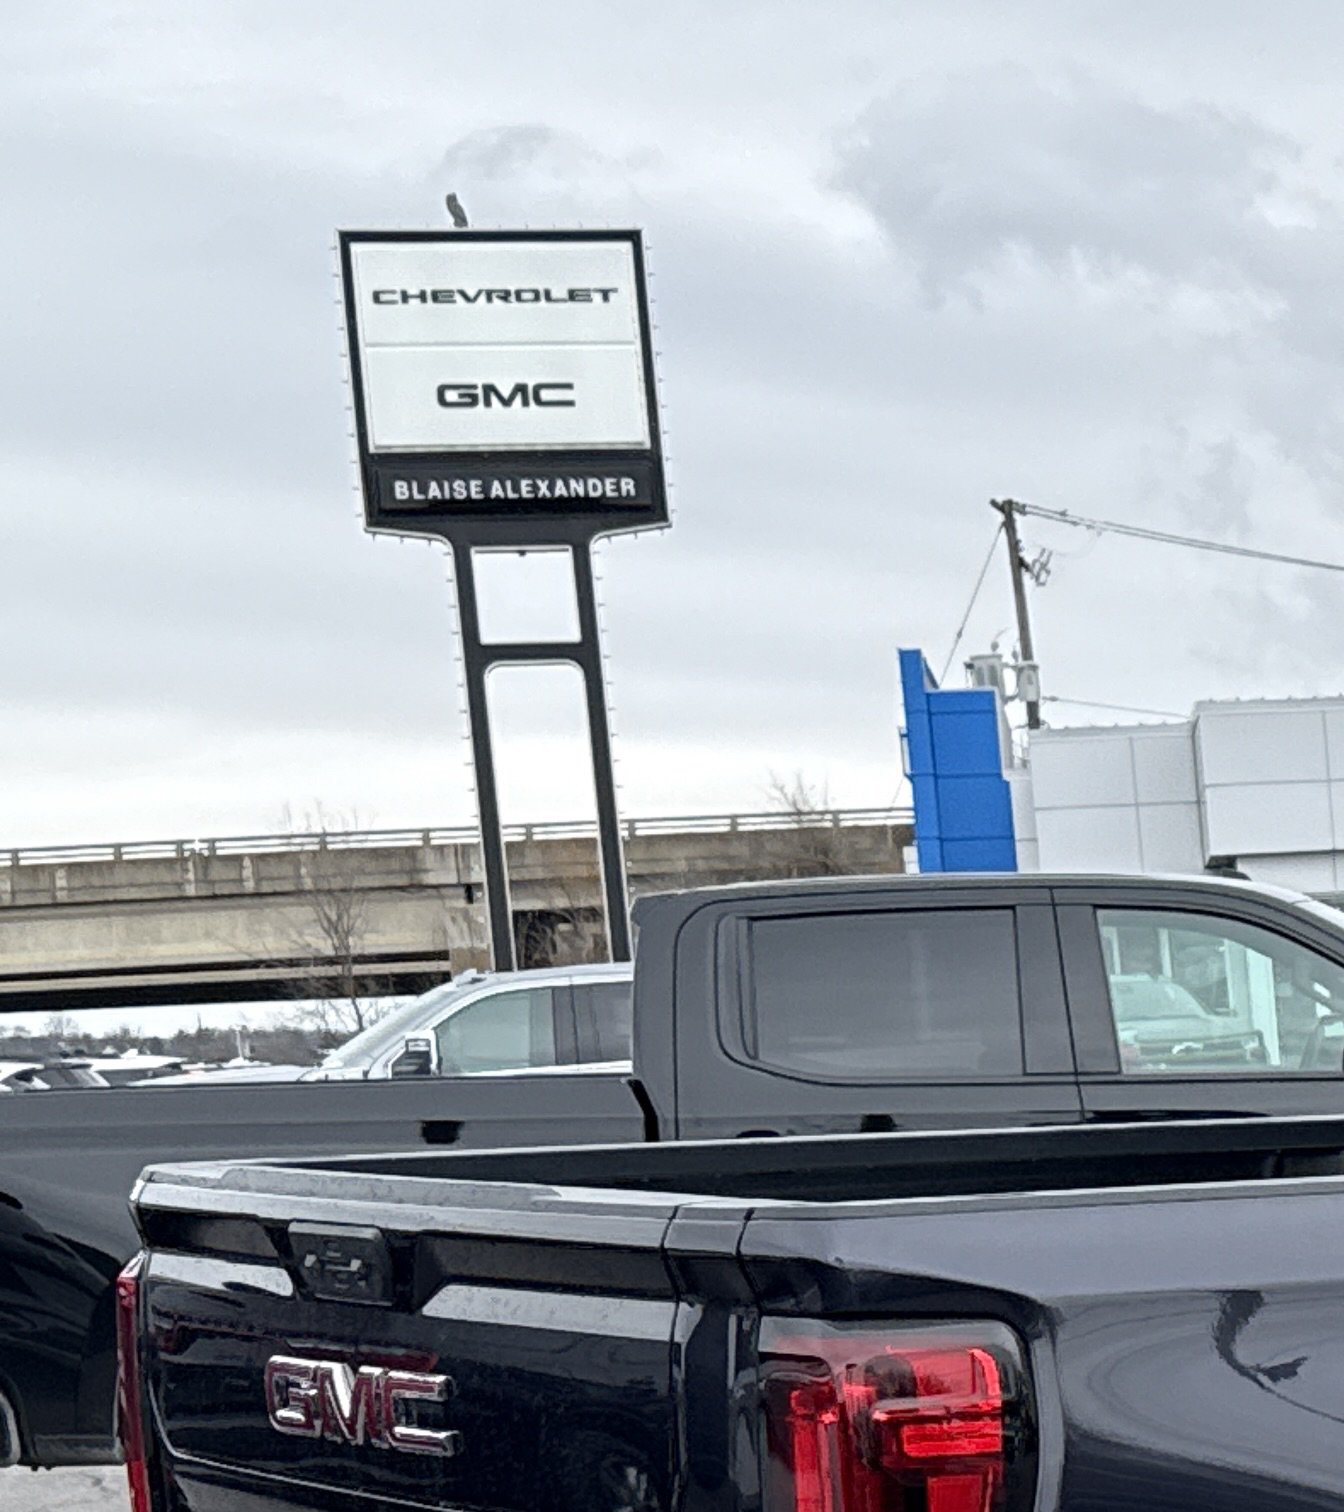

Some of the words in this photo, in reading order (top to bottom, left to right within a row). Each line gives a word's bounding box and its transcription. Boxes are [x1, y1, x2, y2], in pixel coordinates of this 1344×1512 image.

[372, 288, 618, 305] CHEVROLET
[437, 383, 576, 408] GMC
[394, 480, 485, 500] BLAISE
[490, 477, 636, 499] ALEXANDER
[264, 1355, 462, 1457] GMC
